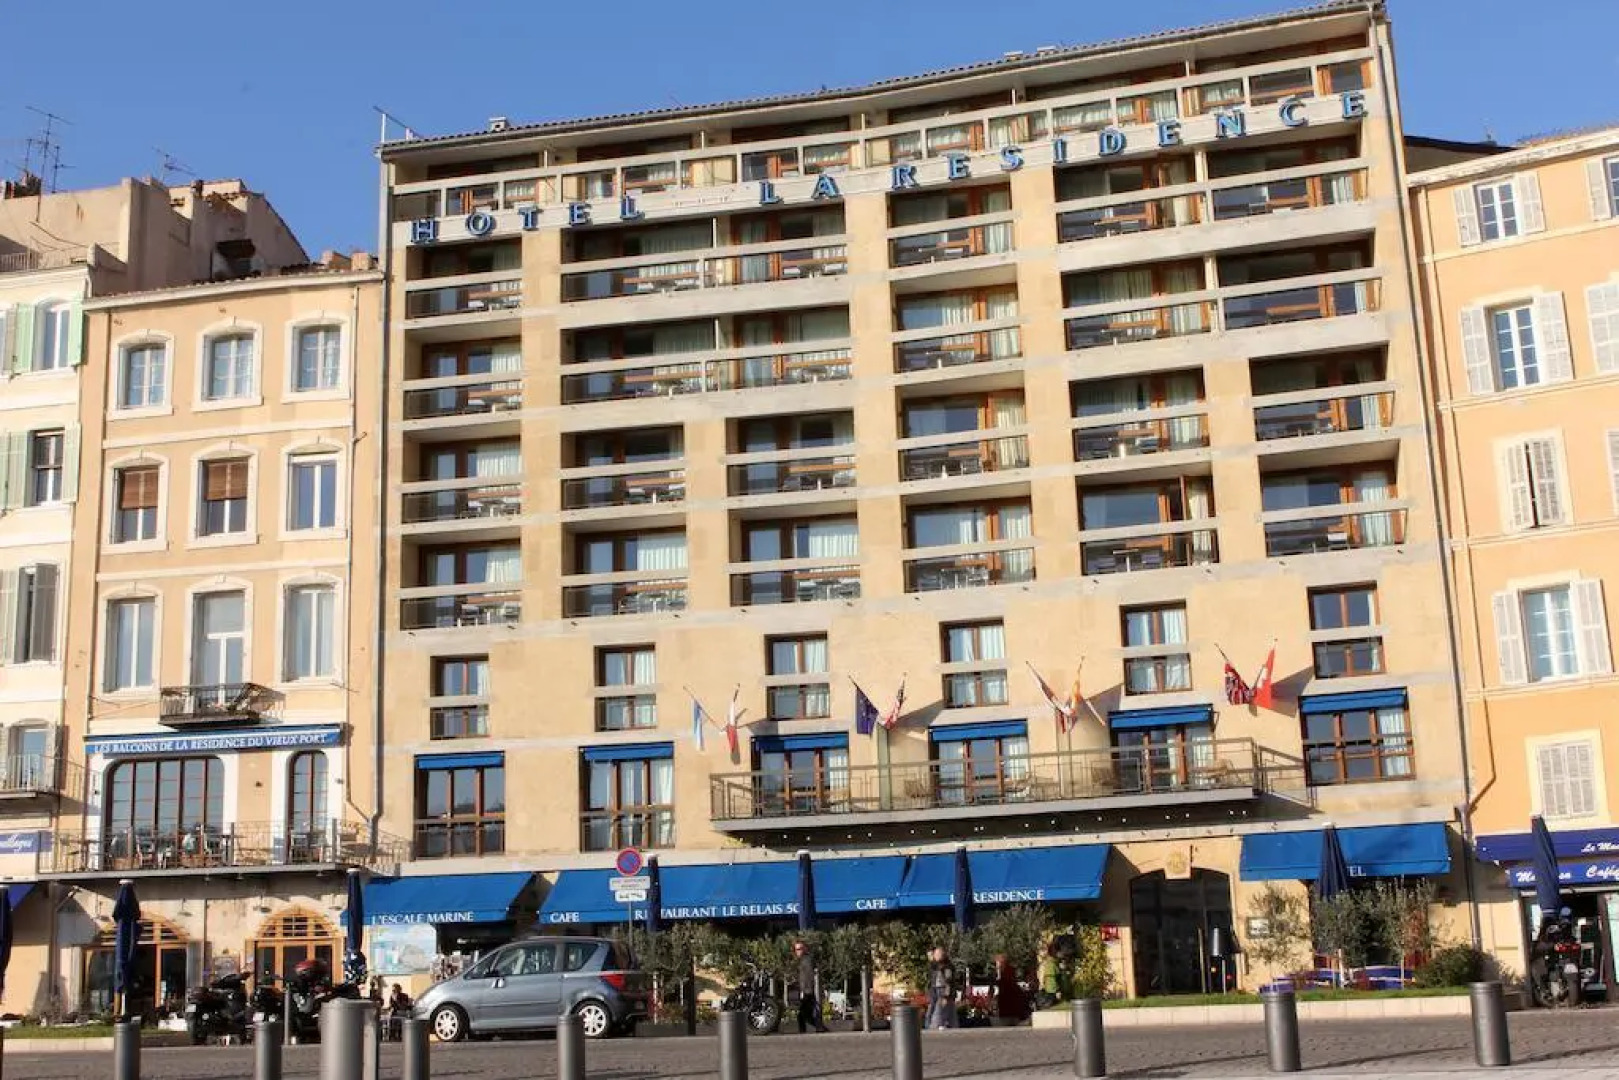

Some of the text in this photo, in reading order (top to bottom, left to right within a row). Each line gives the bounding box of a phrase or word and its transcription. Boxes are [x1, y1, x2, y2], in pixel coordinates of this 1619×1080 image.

[411, 90, 1367, 243] HOTEL LA RESIDENCE
[112, 742, 158, 752] BALCONS
[160, 741, 174, 750] DE
[175, 740, 189, 750] LA
[190, 738, 246, 749] RESIDENCE
[247, 737, 263, 747] DU
[264, 735, 299, 745] VIEUX
[300, 733, 328, 744] PORT
[973, 889, 1045, 904] RESIDENCE
[722, 906, 737, 917] LE
[740, 903, 784, 916] RELAIS
[856, 898, 887, 910] CAFE
[371, 911, 474, 925] L'ESCALE MARINE
[550, 912, 580, 923] CAFE
